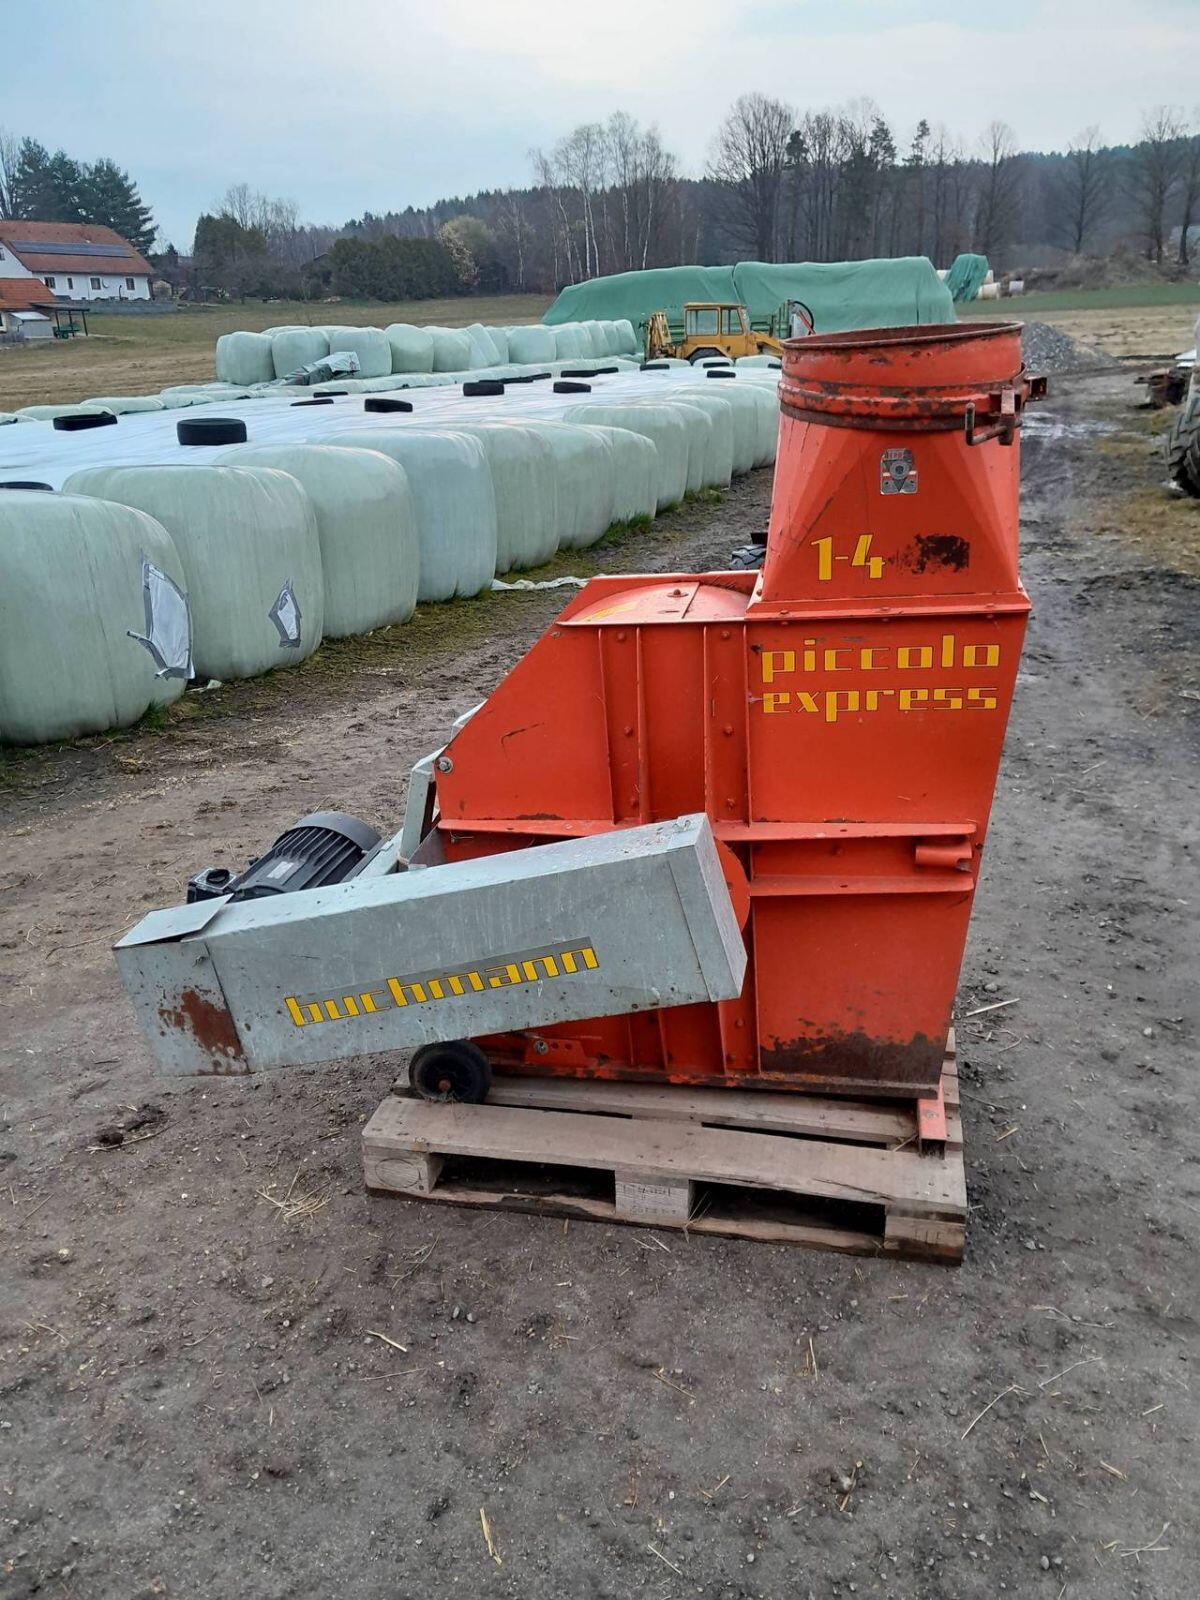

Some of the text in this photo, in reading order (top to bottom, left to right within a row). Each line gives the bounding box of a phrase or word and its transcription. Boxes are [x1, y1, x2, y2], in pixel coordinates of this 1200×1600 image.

[810, 534, 886, 581] 1-4
[762, 634, 1000, 683] piccolo
[762, 687, 998, 723] express
[284, 946, 600, 1027] buchmann
